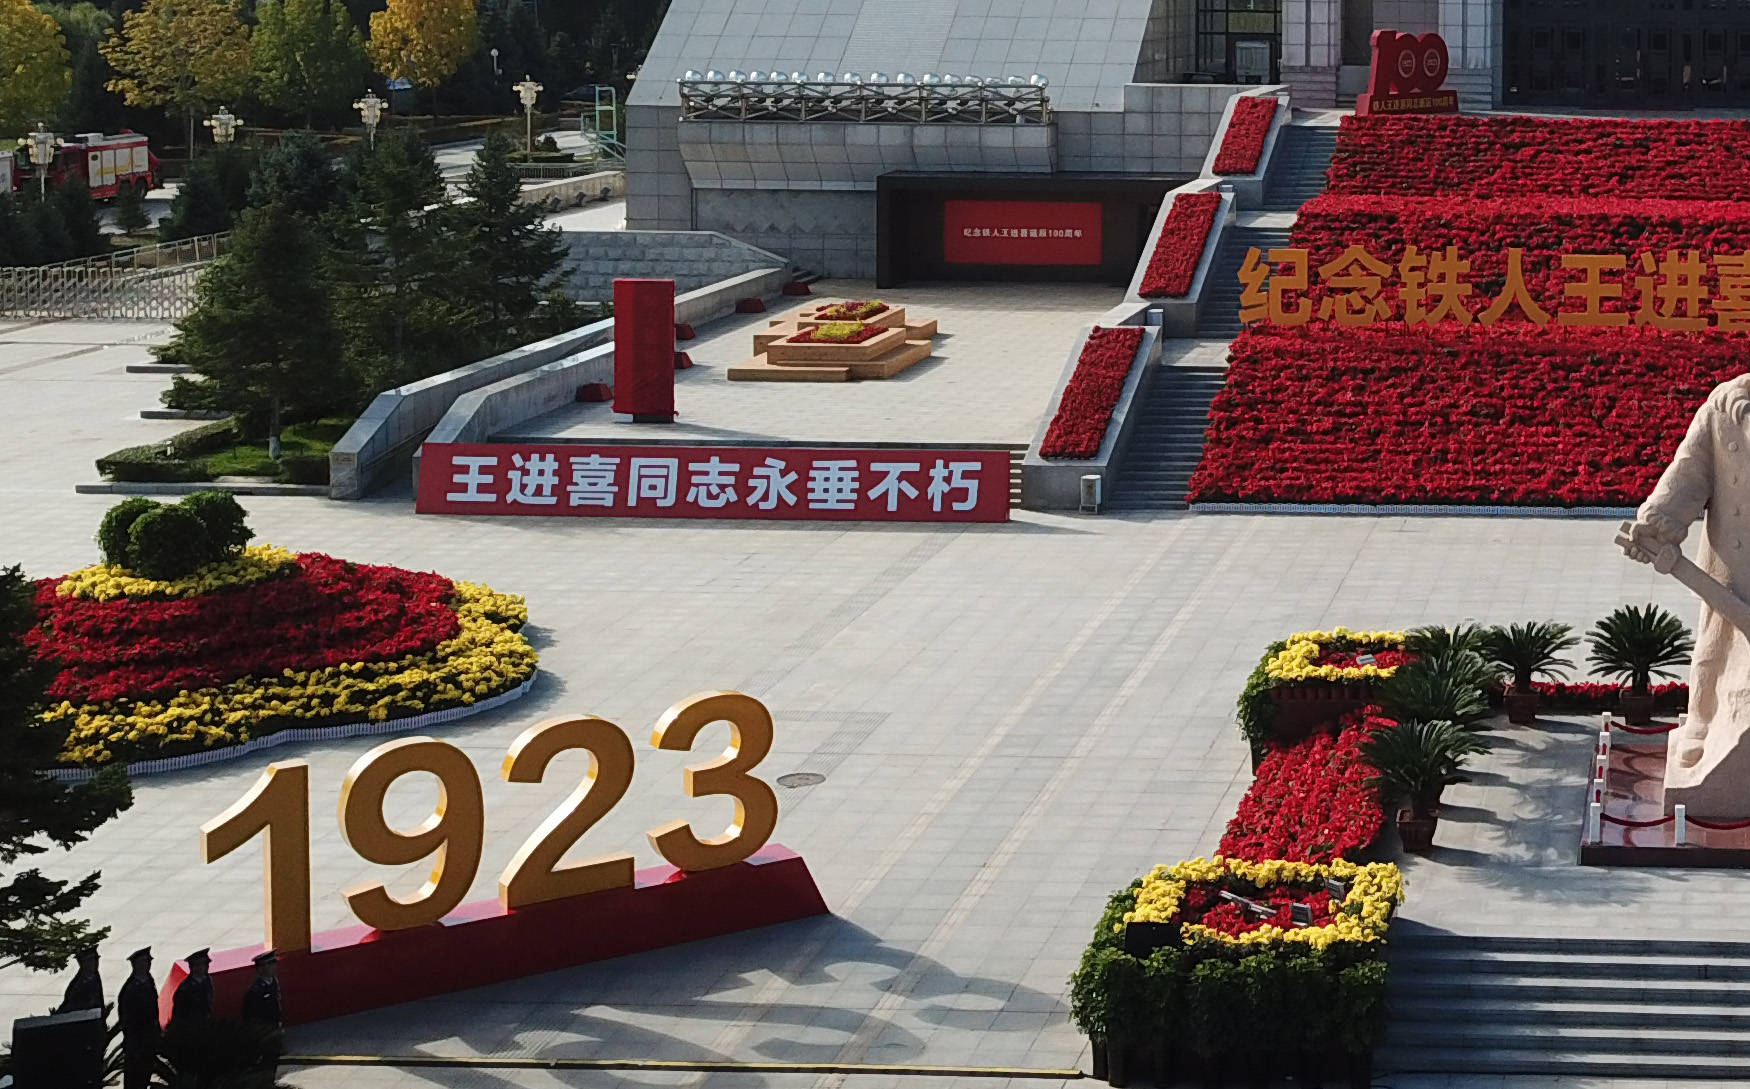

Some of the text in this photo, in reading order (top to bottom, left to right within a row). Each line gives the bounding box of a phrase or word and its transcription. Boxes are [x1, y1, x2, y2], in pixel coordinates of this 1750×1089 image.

[447, 453, 982, 512] 王进喜同志永垂不朽
[200, 689, 778, 954] 1923
